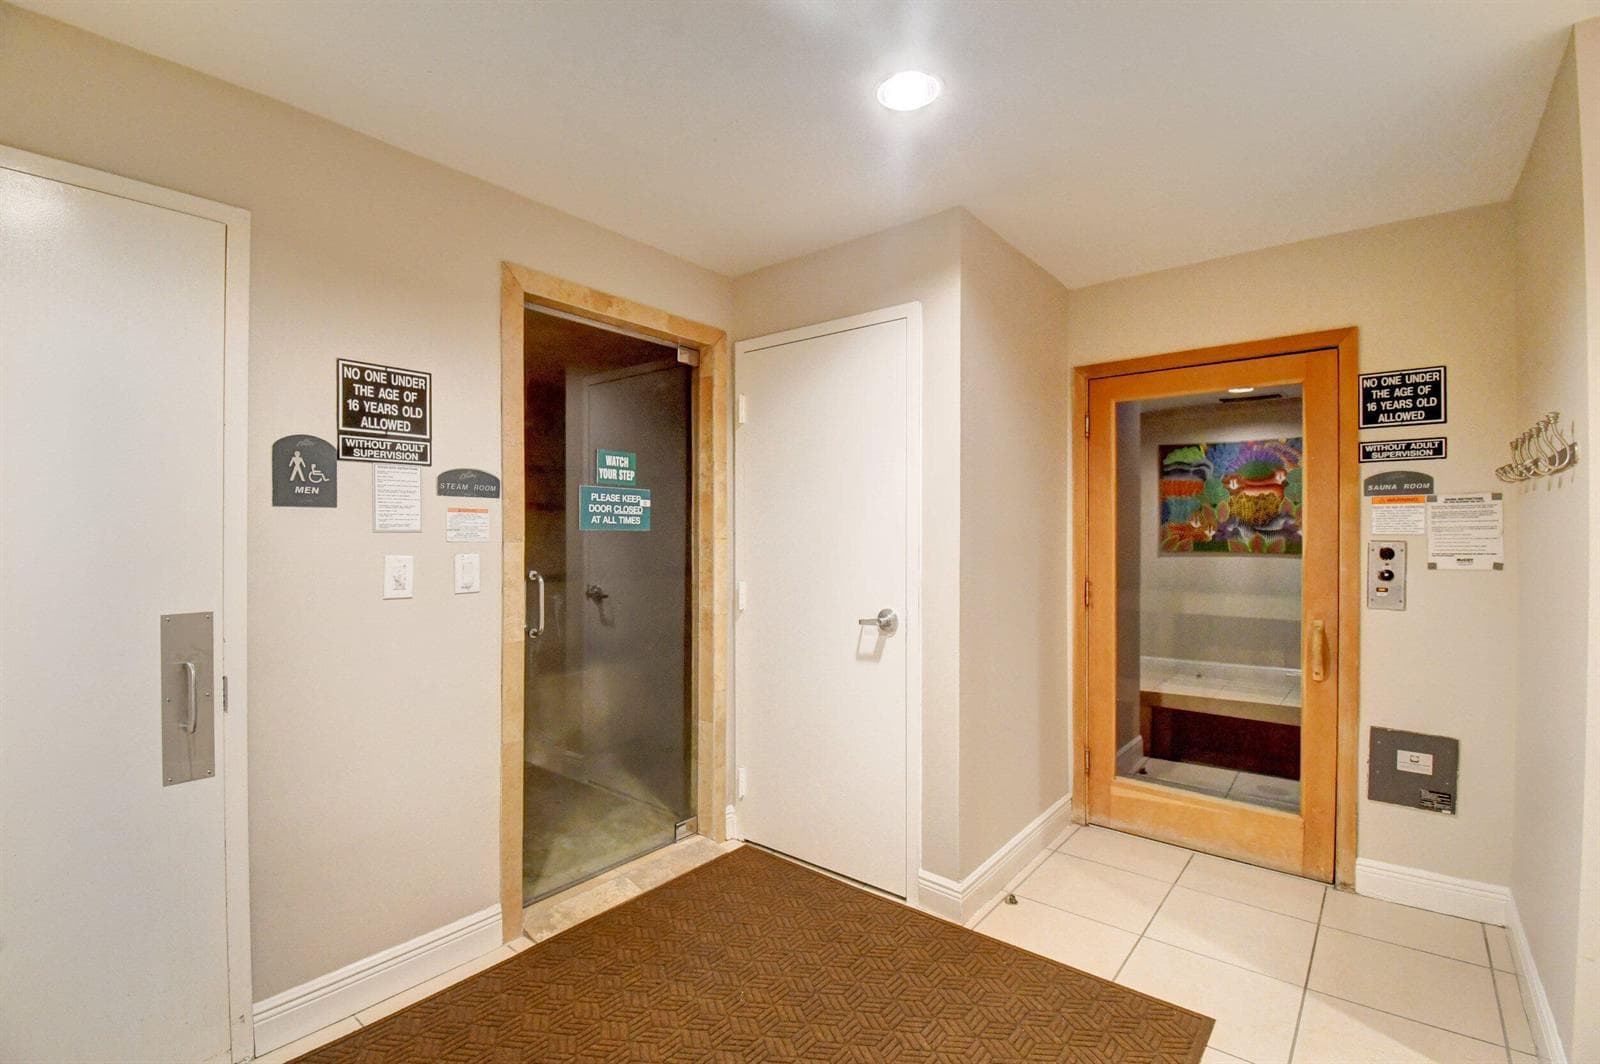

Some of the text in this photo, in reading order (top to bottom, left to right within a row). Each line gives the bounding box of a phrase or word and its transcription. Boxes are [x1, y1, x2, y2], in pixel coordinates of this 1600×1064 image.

[343, 366, 426, 390] NO ONE UNDER
[1363, 372, 1440, 388] NO ONE UNDER
[353, 383, 418, 403] THE AGE OF
[1371, 385, 1432, 399] THE AGE OF
[346, 399, 423, 418] 16 YEARS OLD
[1366, 397, 1437, 412] 16 YEARS OLD
[1378, 410, 1425, 422] ALLOWED
[360, 416, 411, 432] ALLOWED
[345, 438, 424, 453] WITHOUT ADULT
[1365, 441, 1439, 452] WITHOUT ADULT
[353, 448, 418, 460] SUPERVISION
[1371, 449, 1433, 459] SUPERVISION
[605, 455, 629, 468] WATCH
[598, 468, 636, 481] YOUR STEP
[294, 486, 319, 494] MEN
[440, 482, 496, 492] STEAM ROOM
[590, 493, 641, 503] PLEASE KEEP
[588, 504, 643, 515] DOOR CLOSED
[591, 516, 641, 525] AT ALL TIMES
